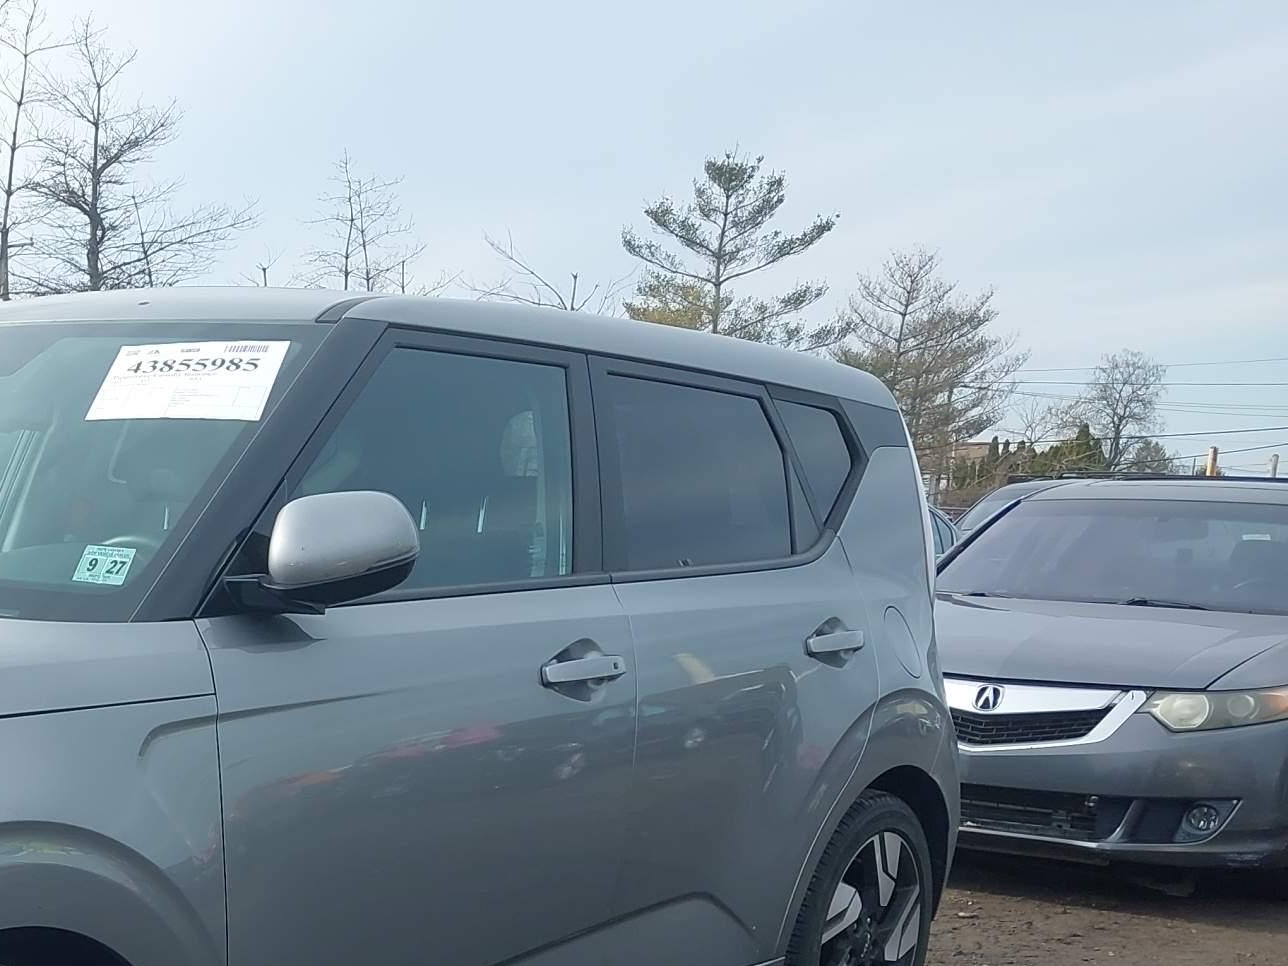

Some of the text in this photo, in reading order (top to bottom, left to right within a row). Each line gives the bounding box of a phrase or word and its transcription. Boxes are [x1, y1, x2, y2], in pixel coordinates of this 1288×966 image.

[127, 357, 260, 374] 43855985
[86, 558, 127, 575] 9 27
